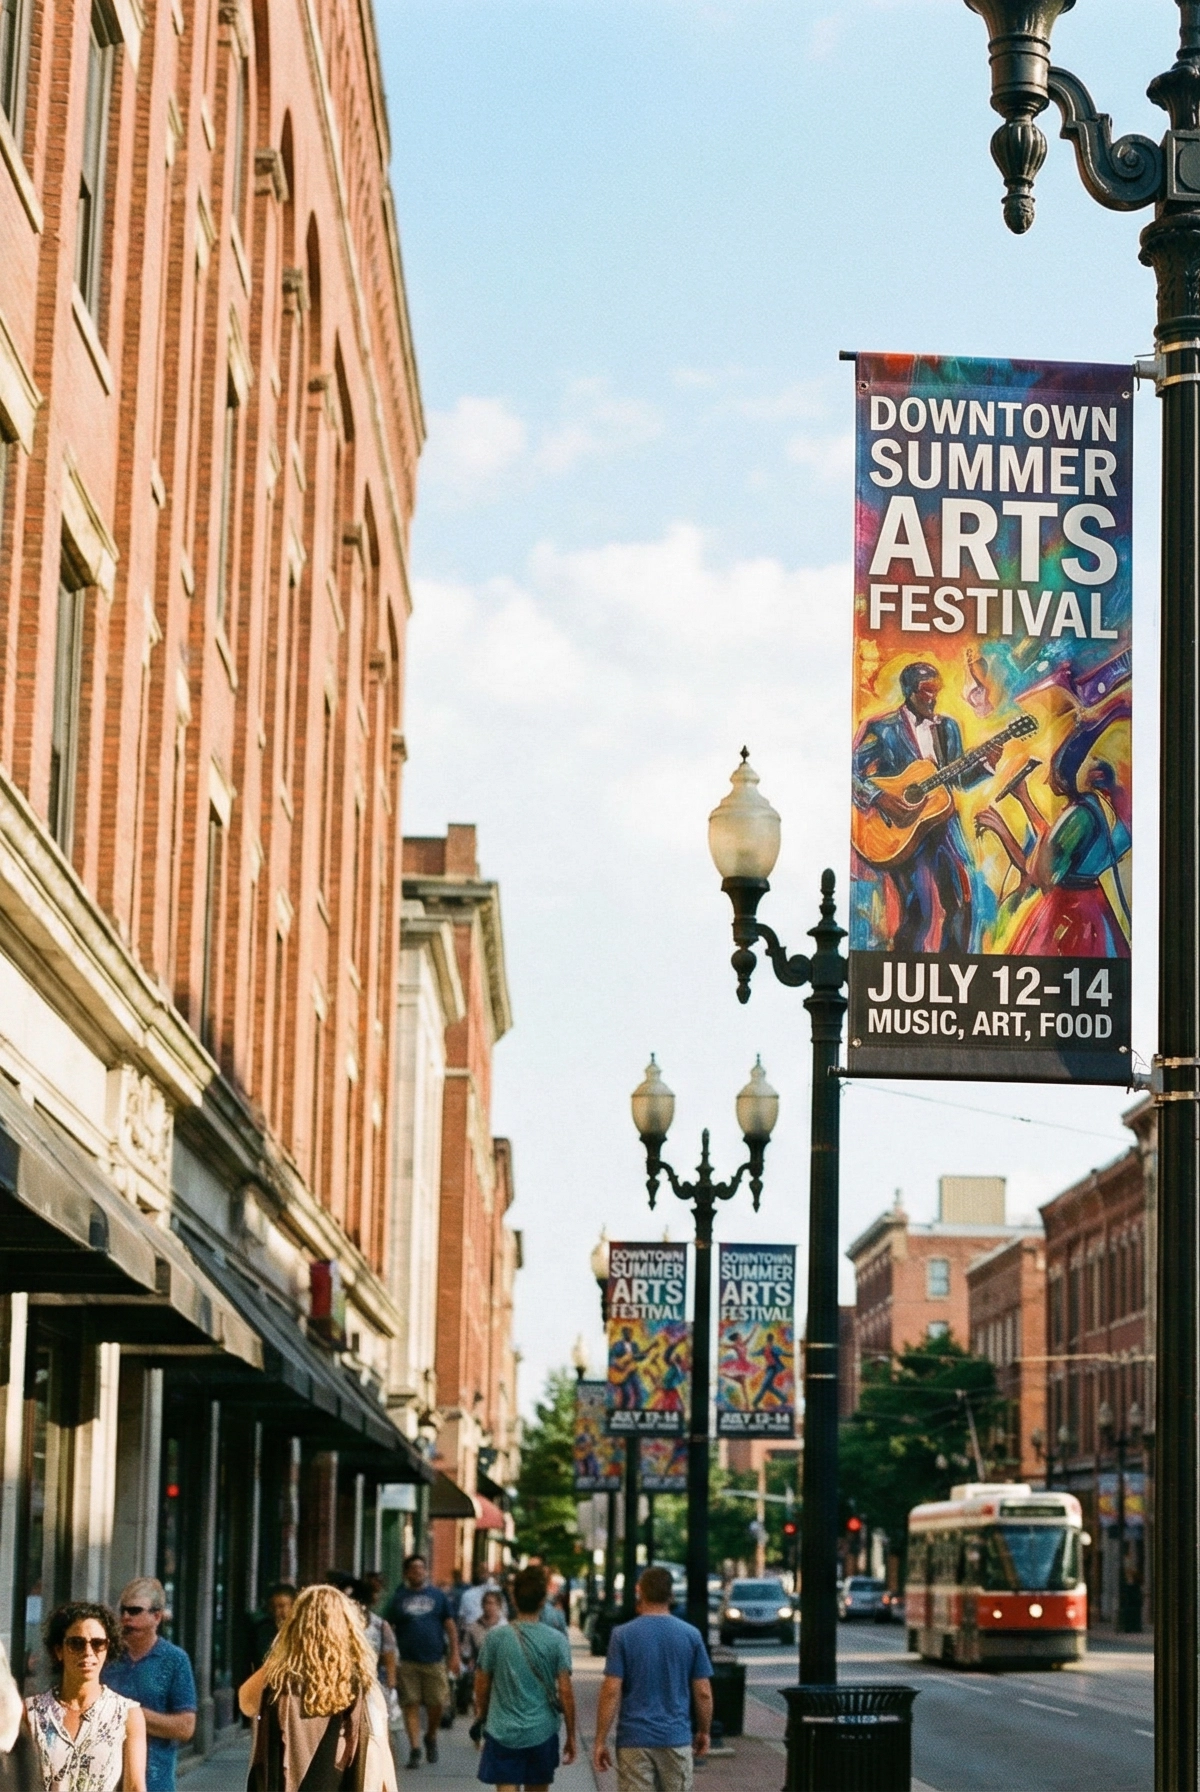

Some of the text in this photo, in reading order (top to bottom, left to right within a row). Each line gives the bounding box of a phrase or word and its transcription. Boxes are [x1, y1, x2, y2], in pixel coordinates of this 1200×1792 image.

[870, 395, 1117, 442] DOWNTOWN
[869, 438, 1117, 497] SUMMER
[868, 495, 1118, 586] ARTS
[869, 583, 1118, 640] FESTIVAL
[867, 961, 1113, 1009] JULY 12-14
[867, 1007, 1113, 1043] MUSIC, ART, FOOD
[611, 1249, 685, 1262] DOWNTOWN
[721, 1251, 793, 1265] DOWNTOWN
[610, 1261, 685, 1280] SUMMER
[720, 1263, 794, 1281] SUMMER
[612, 1279, 684, 1305] ARTS
[720, 1280, 792, 1307] ARTS
[611, 1304, 682, 1320] FESTIVAL
[721, 1306, 792, 1321] FESTIVAL
